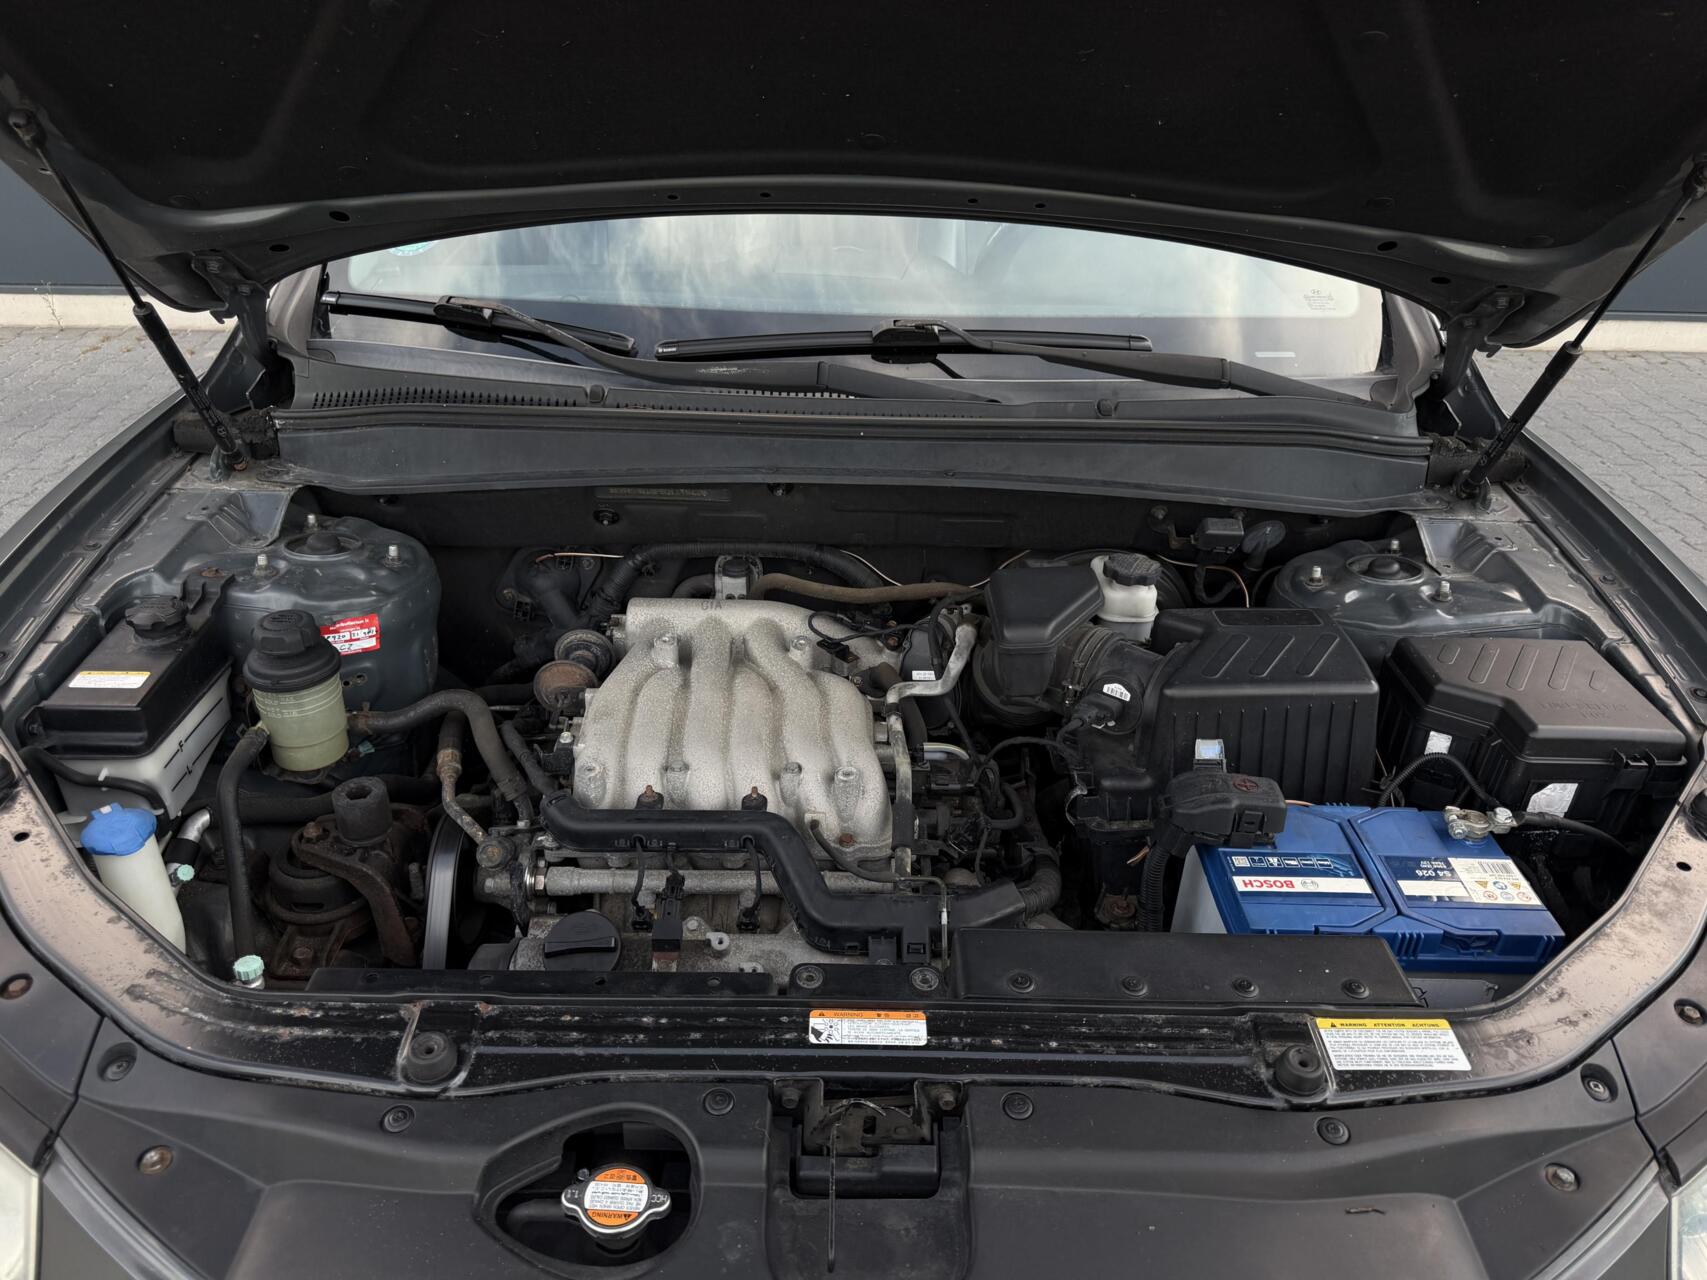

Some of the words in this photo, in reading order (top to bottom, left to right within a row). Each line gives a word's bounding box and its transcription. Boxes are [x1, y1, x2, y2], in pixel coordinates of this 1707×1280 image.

[178, 740, 184, 752] F
[186, 765, 193, 775] L
[1415, 869, 1436, 877] 026
[1241, 879, 1296, 889] BOSCH
[592, 1211, 623, 1219] WARNING
